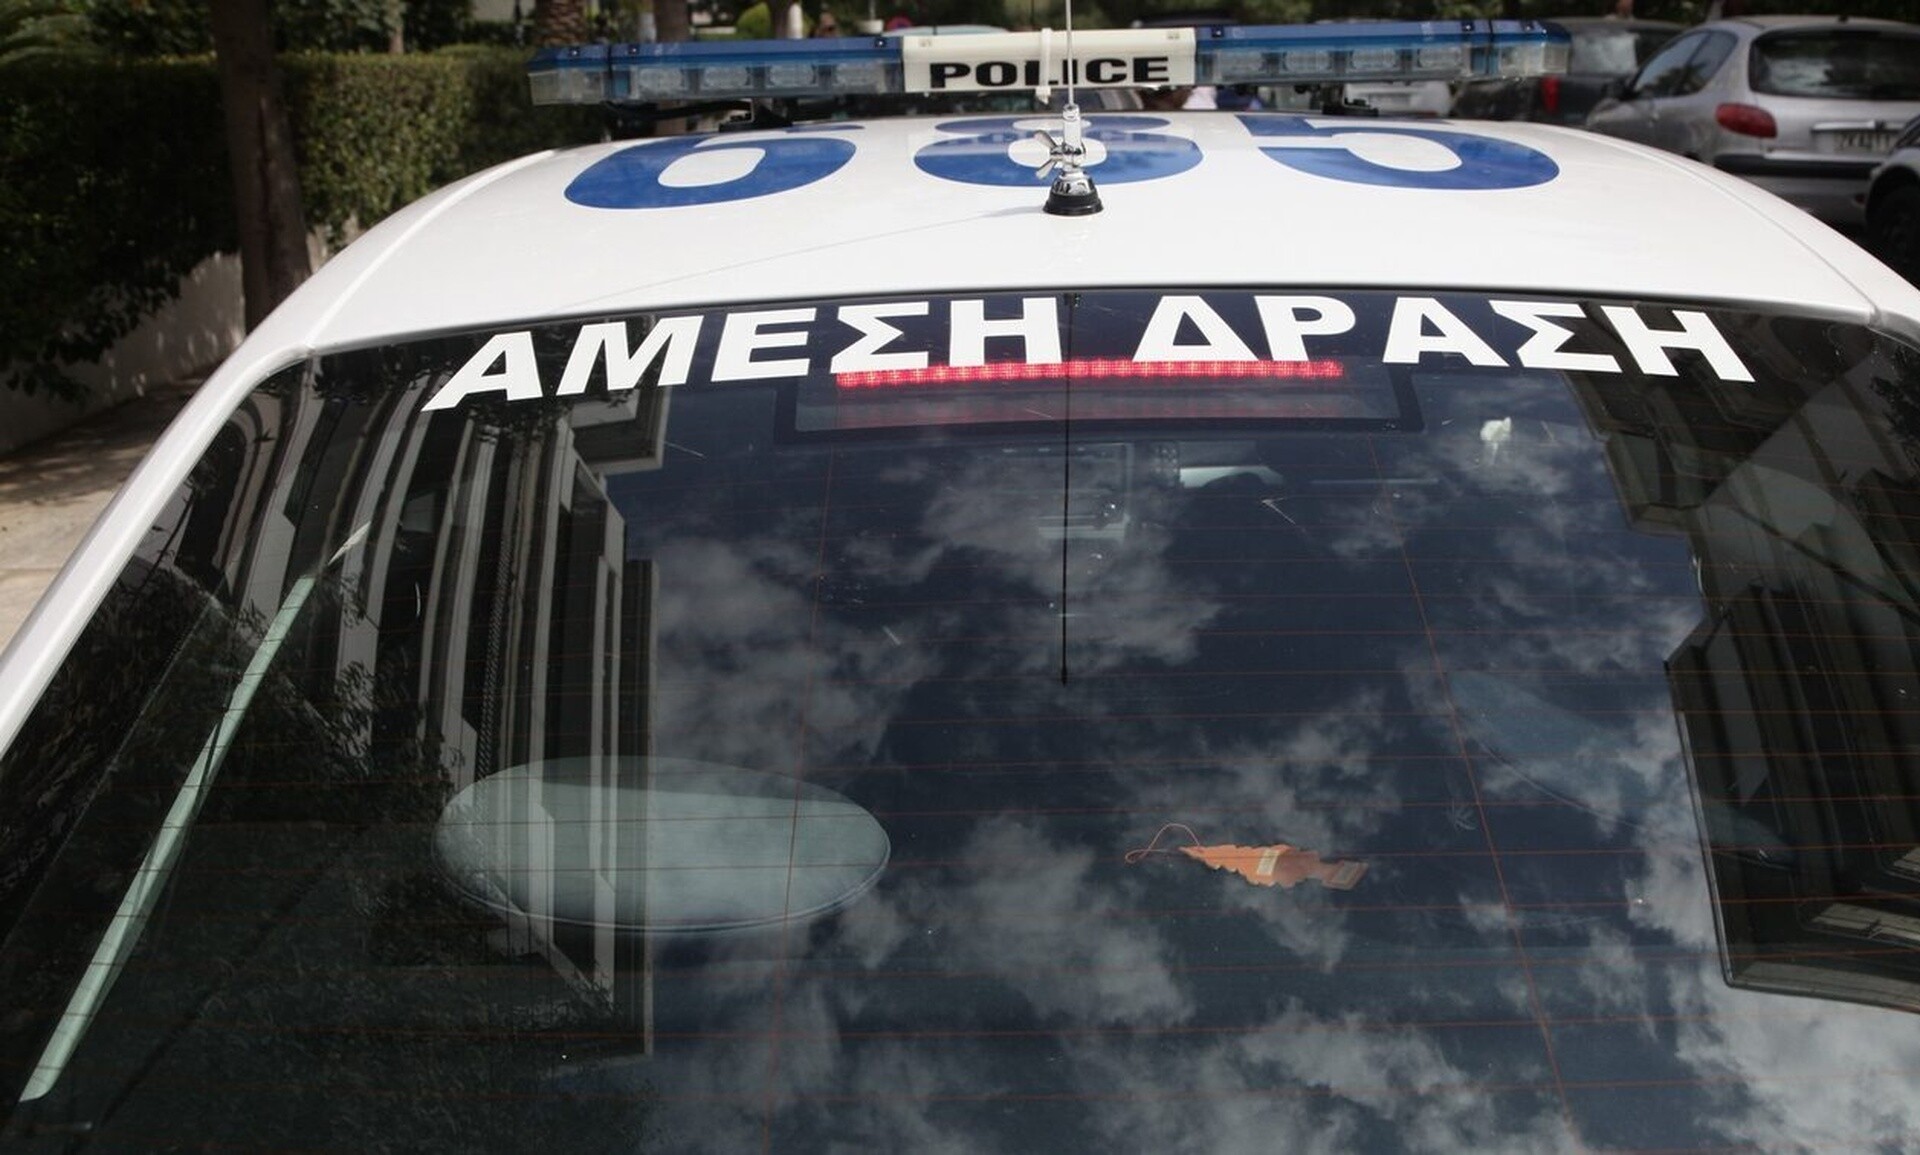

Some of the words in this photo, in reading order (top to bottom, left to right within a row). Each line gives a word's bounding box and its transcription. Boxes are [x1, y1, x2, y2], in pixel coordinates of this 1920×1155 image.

[930, 56, 1169, 88] POLICE
[564, 114, 1559, 209] 685
[422, 298, 1061, 411] ΑΜΕΣΗ
[1133, 295, 1755, 382] ΔΡΑΣΗ
